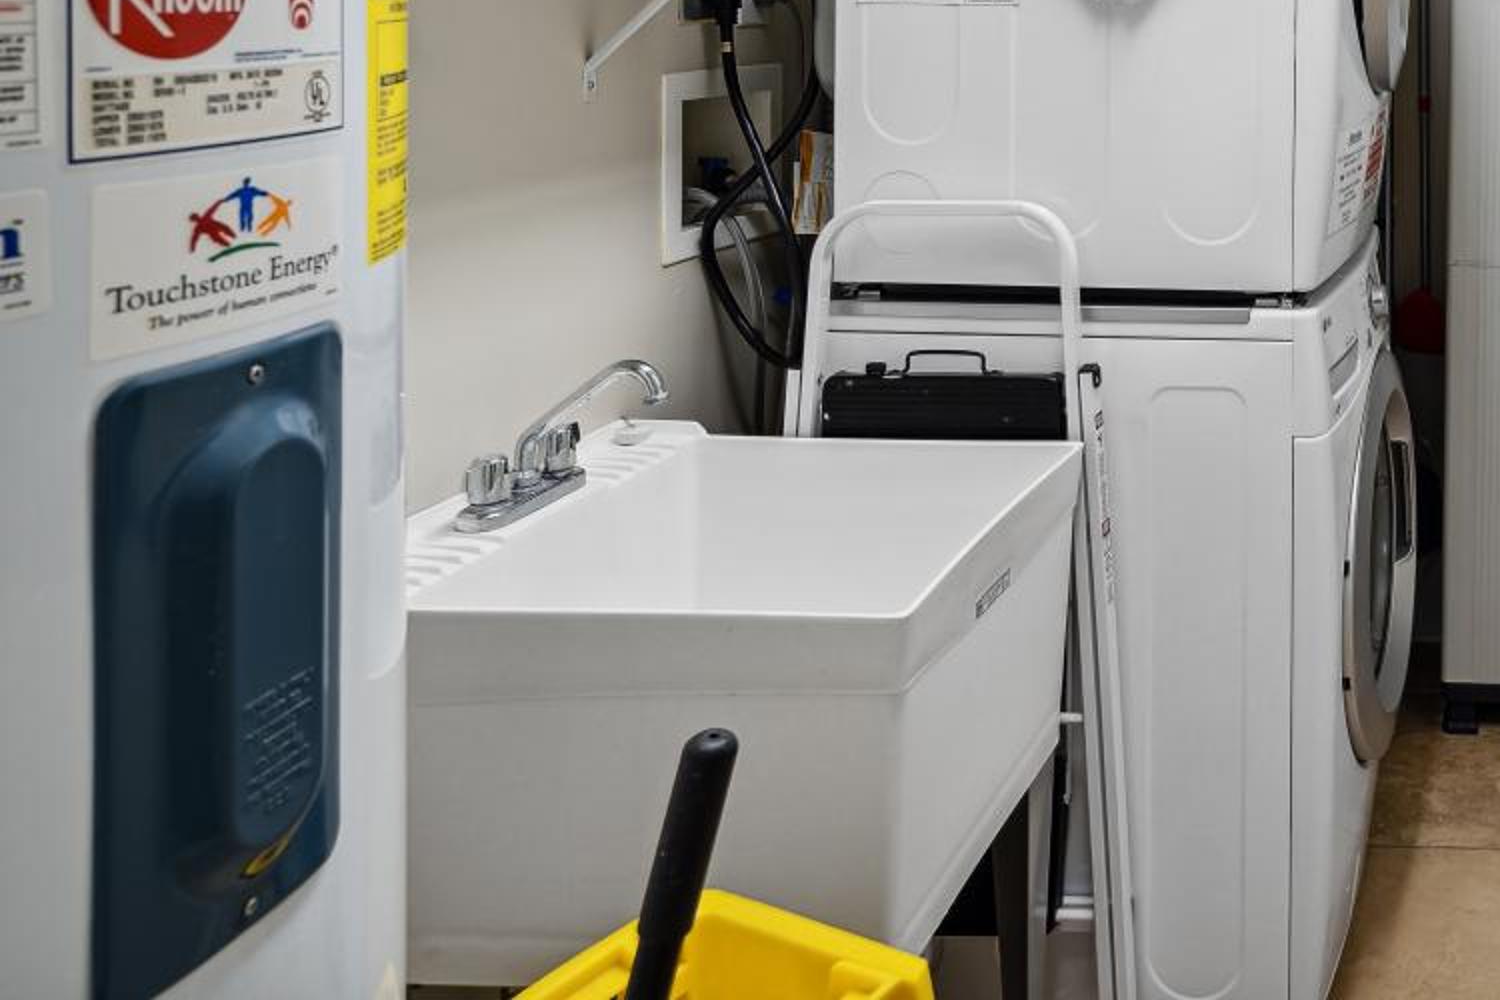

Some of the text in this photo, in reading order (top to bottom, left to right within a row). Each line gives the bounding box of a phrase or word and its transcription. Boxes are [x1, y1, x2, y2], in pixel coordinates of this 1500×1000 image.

[105, 274, 263, 315] Touchstone
[149, 315, 174, 330] The
[177, 308, 215, 327] power
[217, 301, 229, 316] of
